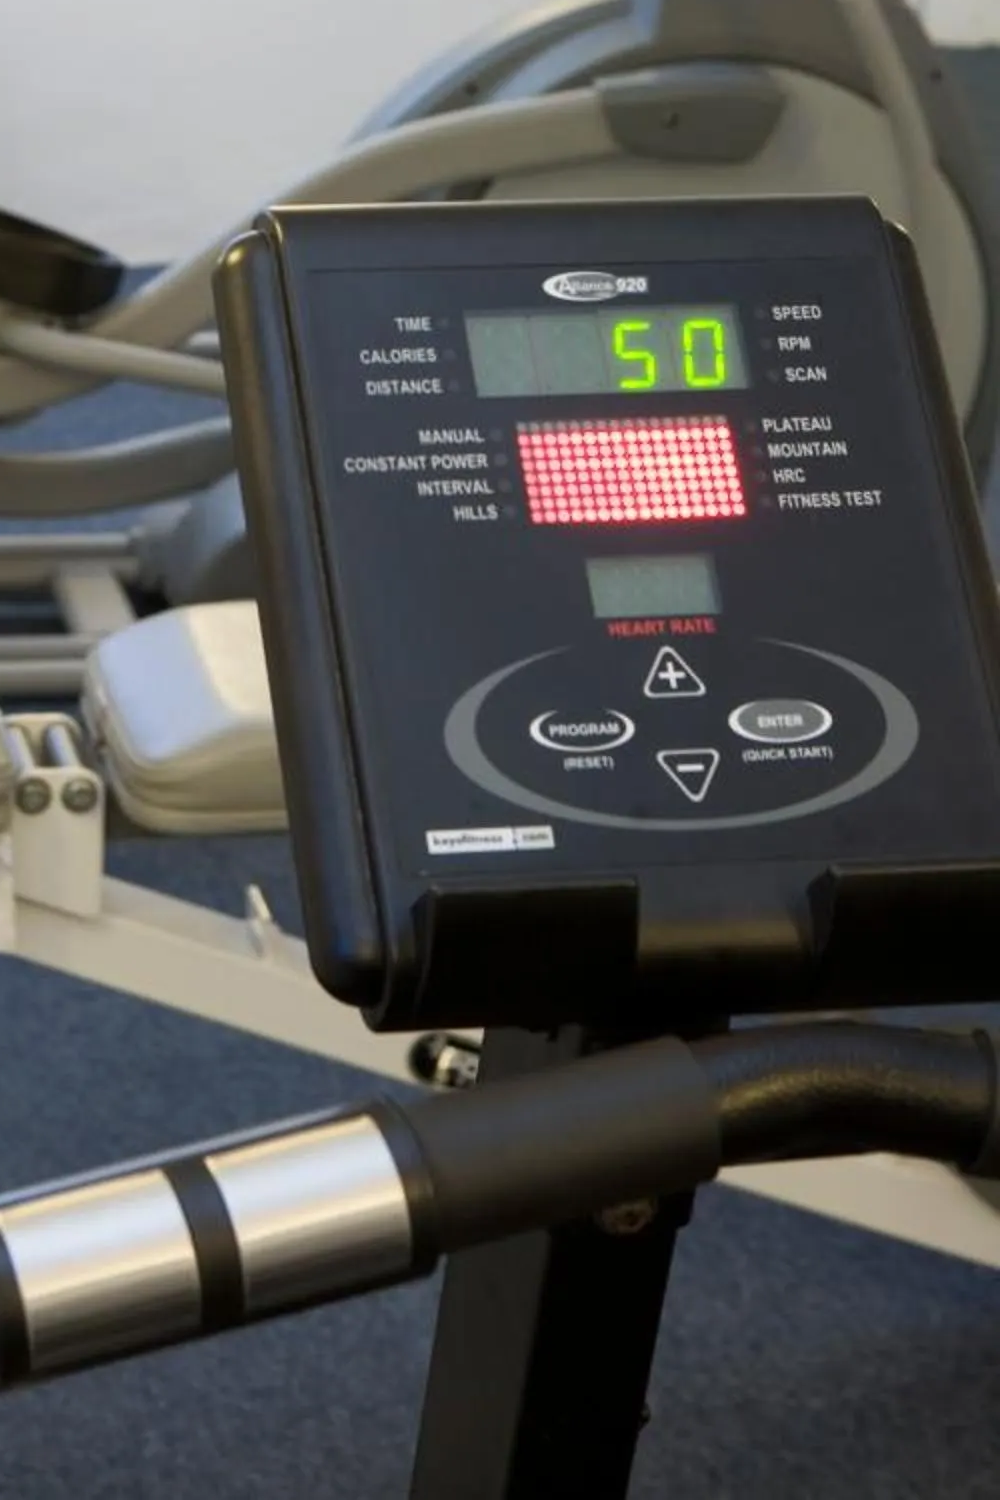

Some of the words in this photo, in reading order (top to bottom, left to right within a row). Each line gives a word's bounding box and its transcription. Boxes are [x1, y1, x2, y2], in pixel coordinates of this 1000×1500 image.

[616, 278, 647, 293] 920
[772, 304, 822, 321] SPEED
[394, 316, 432, 332] TIME
[777, 335, 812, 352] RPM
[359, 347, 438, 365] CALORIES
[784, 365, 828, 383] SCAN
[365, 378, 443, 396] DISTANCE
[761, 415, 833, 433] PLATEAU
[417, 428, 485, 445] MANUAL
[766, 440, 849, 459] MOUNTAIN
[343, 455, 427, 474] CONSTANT
[430, 452, 489, 470] POWER
[772, 466, 807, 485] HRC
[416, 479, 496, 497] INTERVAL
[777, 490, 842, 510] FITNESS
[843, 488, 883, 507] TEST
[452, 503, 500, 522] HILLS
[607, 619, 666, 638] HEART
[669, 615, 717, 635] RATE
[547, 720, 621, 738] PROGRAM
[756, 712, 805, 729] ENTER
[562, 755, 616, 772] (RESET)
[742, 748, 788, 764] (QUICK
[788, 745, 834, 762] START)
